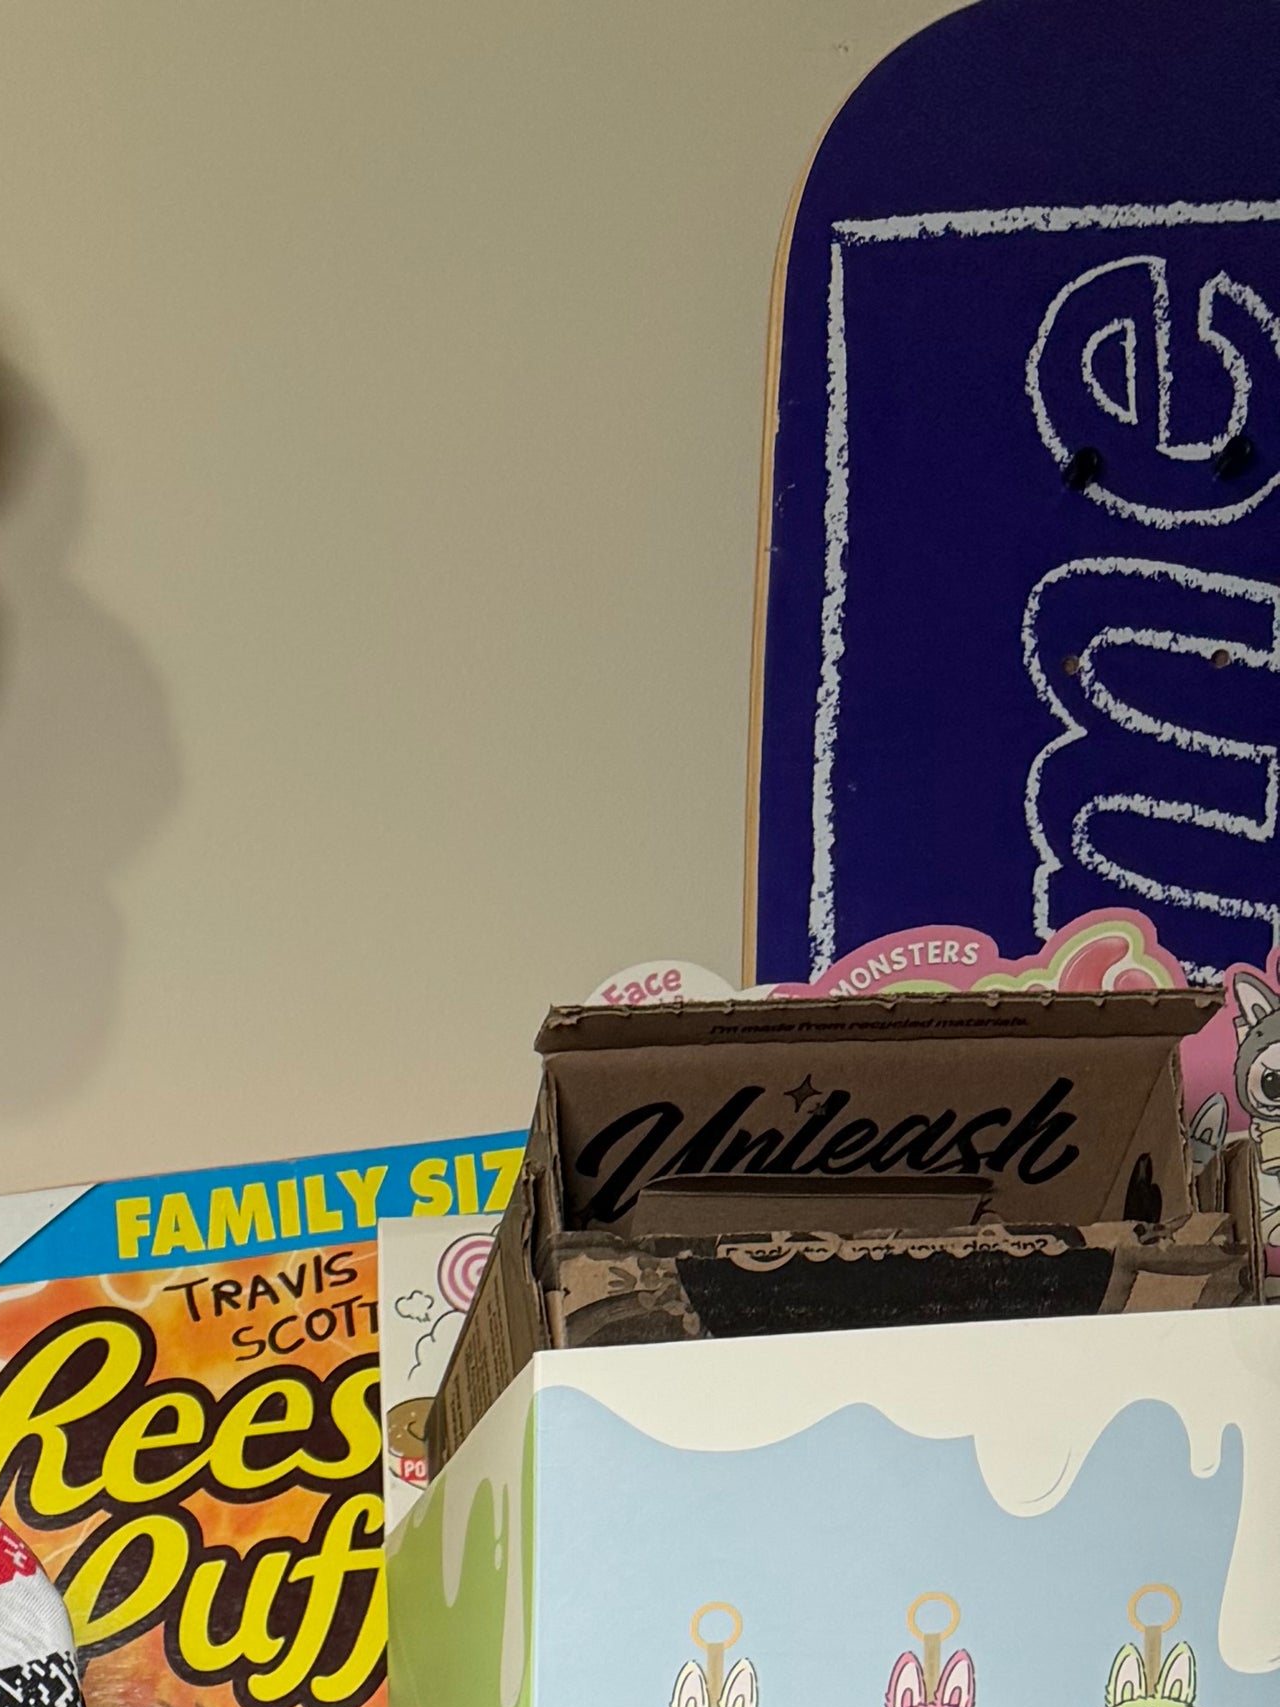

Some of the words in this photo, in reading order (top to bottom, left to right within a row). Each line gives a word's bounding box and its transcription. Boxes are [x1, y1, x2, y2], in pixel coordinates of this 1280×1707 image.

[827, 938, 981, 999] MONSTERS
[576, 1076, 1081, 1223] Unleash
[114, 1165, 389, 1260] FAMILY
[163, 1250, 359, 1324] TRAVIS
